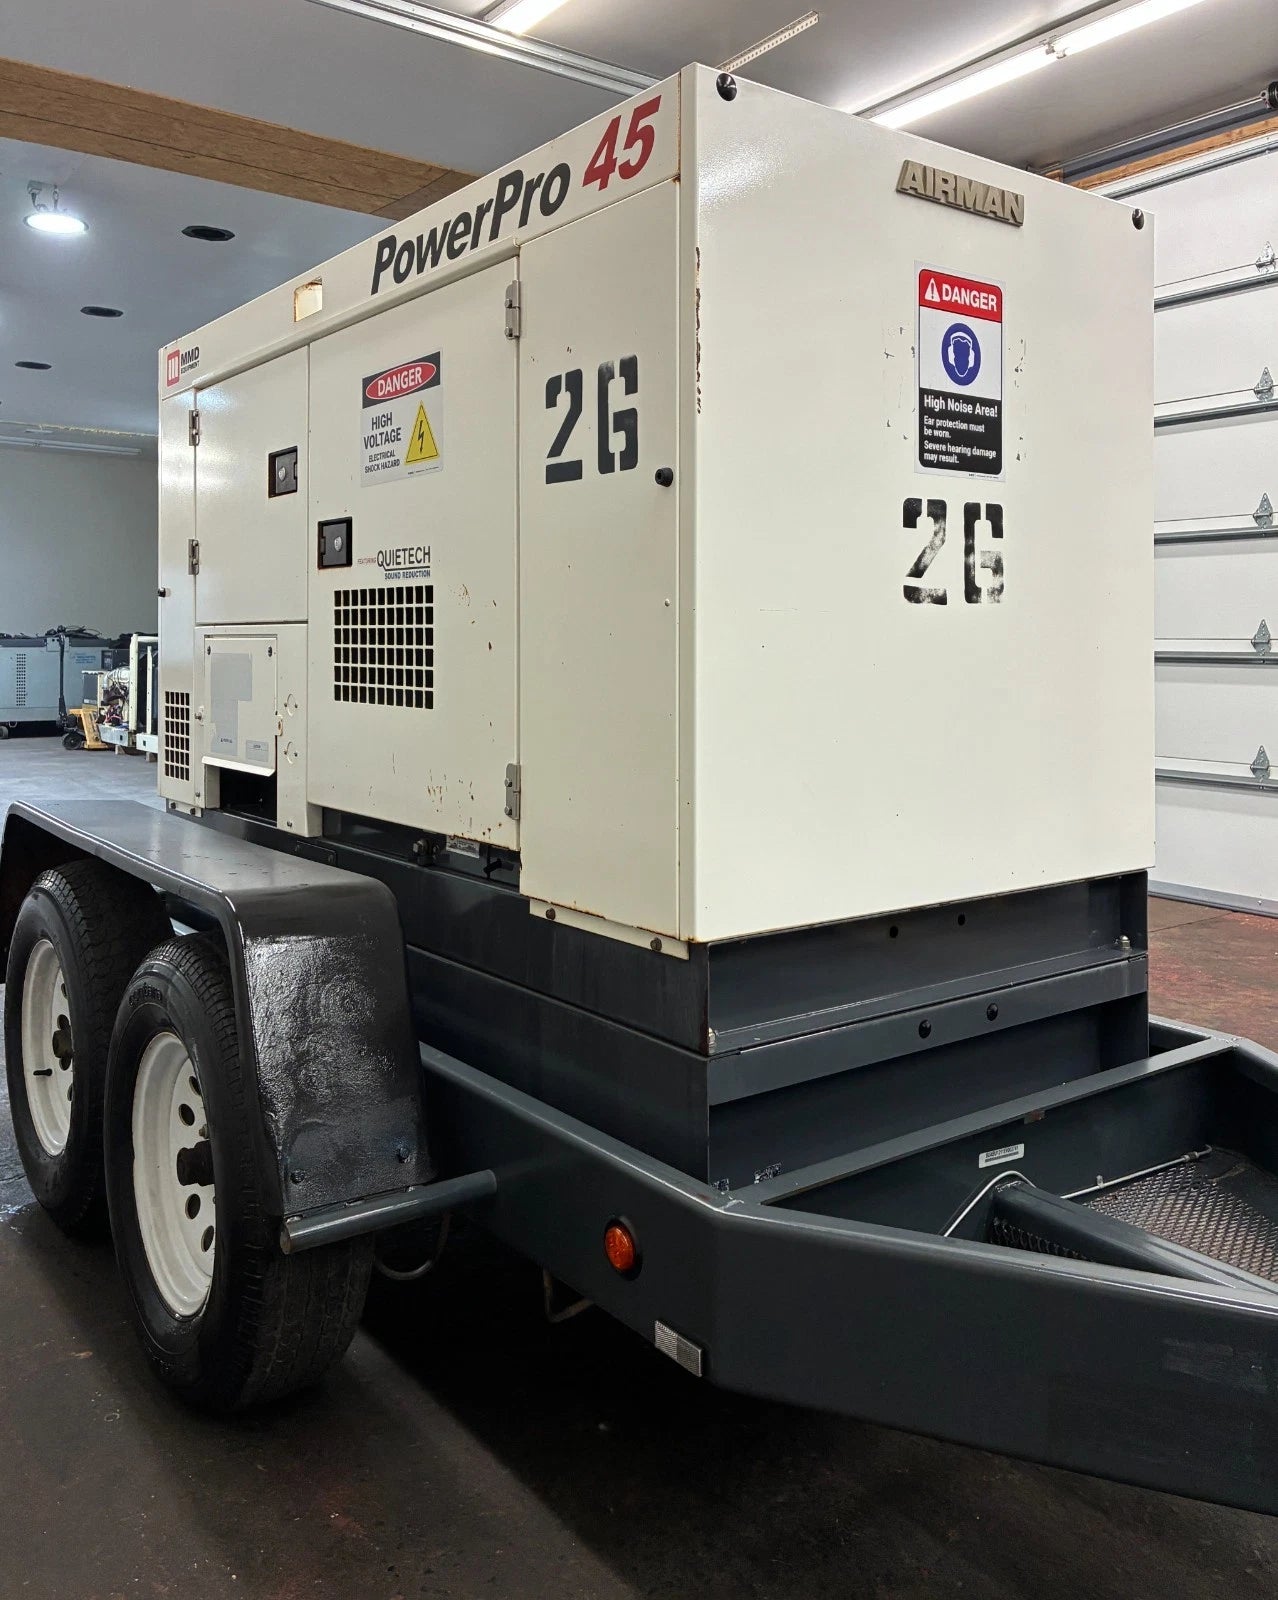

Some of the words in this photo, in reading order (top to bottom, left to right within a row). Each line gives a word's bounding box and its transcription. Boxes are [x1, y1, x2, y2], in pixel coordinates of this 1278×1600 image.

[371, 162, 571, 296] PowerPro
[582, 94, 662, 192] 45
[899, 160, 1025, 225] AIRMAN
[942, 283, 998, 312] DANGER
[181, 346, 200, 367] MMD
[377, 366, 423, 397] DANGER
[923, 394, 946, 412] High
[947, 398, 973, 414] Noise
[974, 402, 998, 418] Area!
[371, 411, 393, 431] HIGH
[923, 415, 935, 426] Ear
[935, 419, 969, 431] protection
[969, 423, 985, 433] must
[363, 427, 402, 450] VOLTAGE
[923, 426, 933, 436] be
[933, 429, 952, 438] worn.
[368, 449, 396, 463] ELECTRICAL
[923, 440, 947, 452] Severe
[947, 442, 972, 457] hearing
[972, 446, 997, 459] damage
[923, 452, 938, 463] may
[938, 454, 960, 464] result.
[364, 463, 381, 474] SHOCK
[380, 458, 401, 471] HAZARD
[377, 545, 431, 568] QUIETECH
[384, 571, 402, 580] SOUND
[402, 569, 431, 579] REDUCTION
